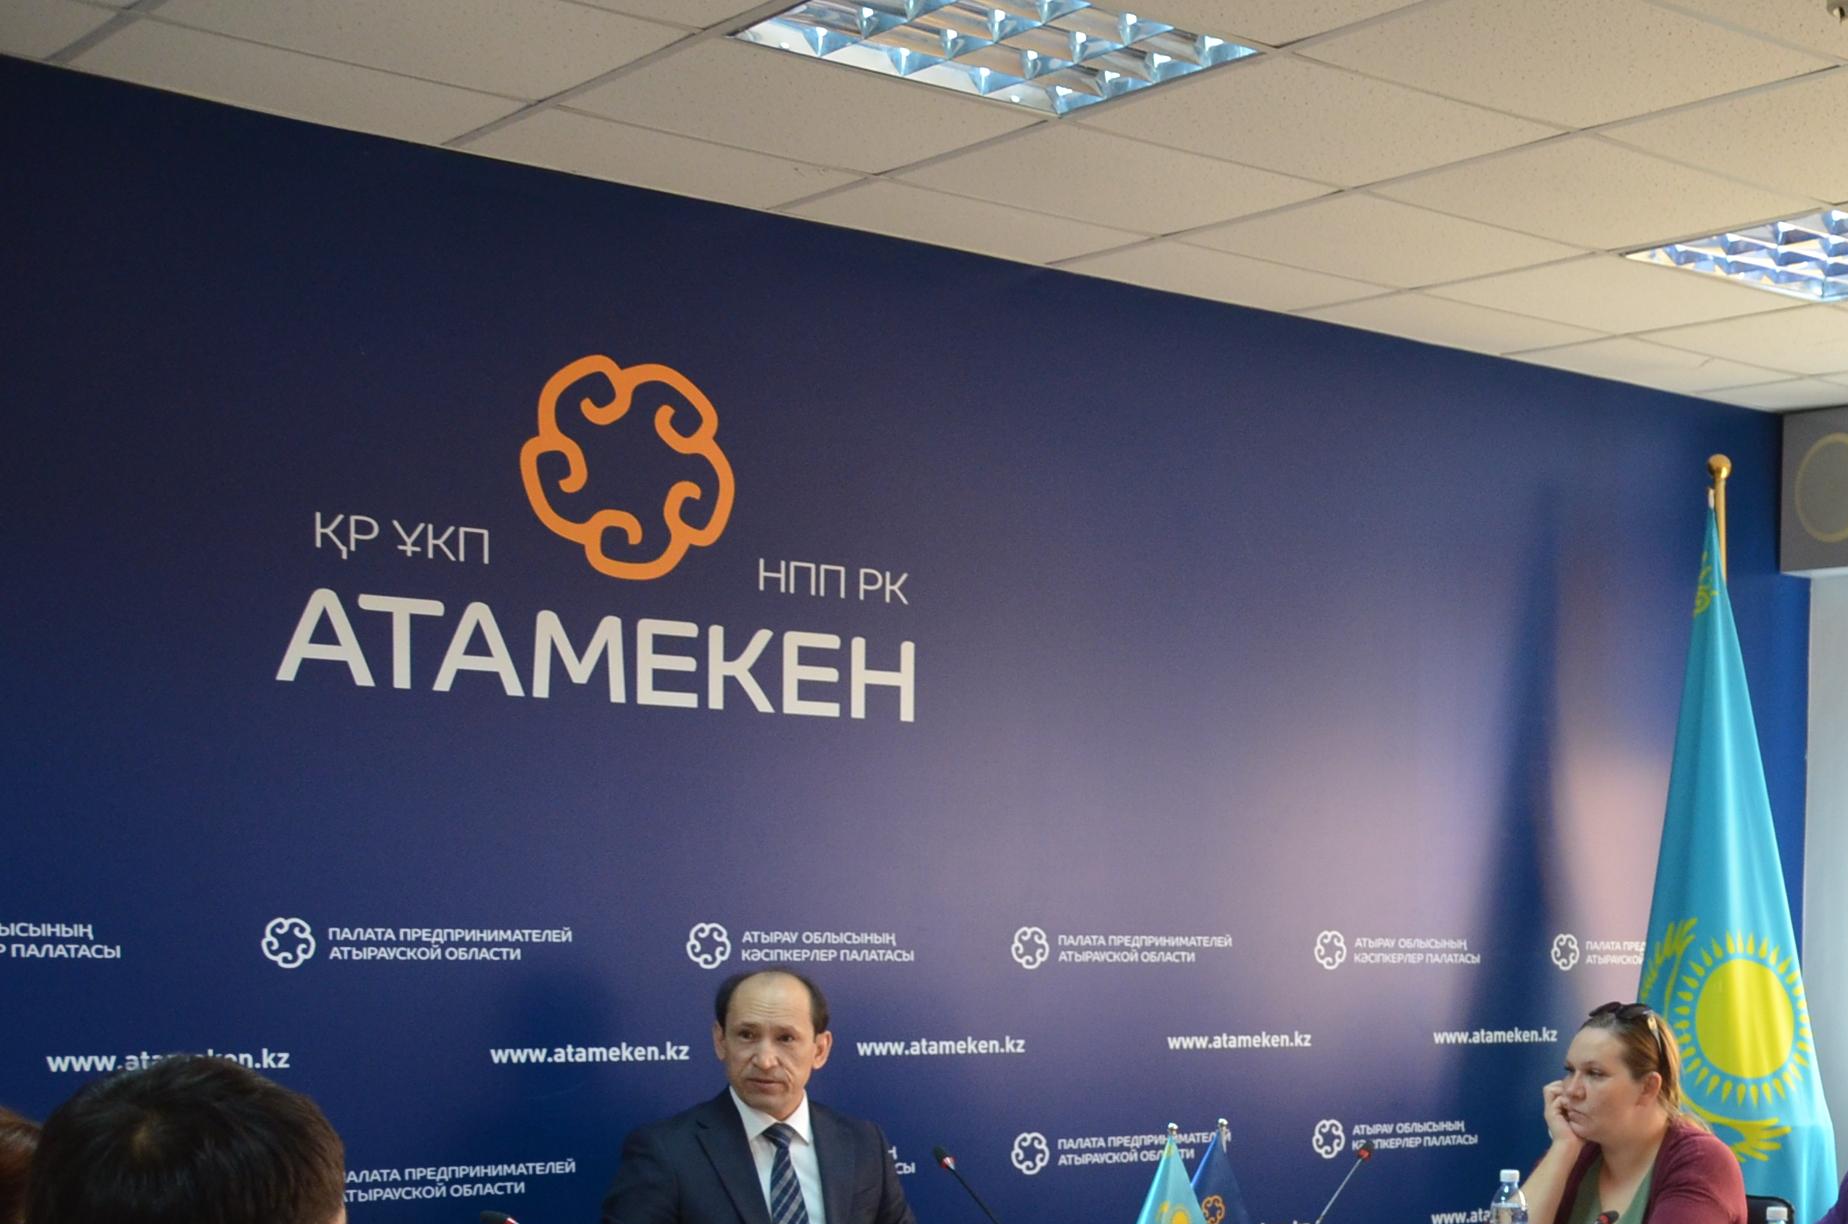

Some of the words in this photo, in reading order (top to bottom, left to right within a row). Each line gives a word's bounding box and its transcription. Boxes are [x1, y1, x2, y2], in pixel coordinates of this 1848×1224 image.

[315, 511, 380, 560] ҚР
[392, 519, 489, 565] ҰКП
[758, 558, 846, 599] НПП
[859, 568, 909, 605] РК
[275, 588, 916, 723] АТАМЕКЕН
[328, 927, 397, 941] ПАЛАТА
[398, 926, 573, 946] ПРЕДПРИНИМАТЕЛЕЙ
[742, 931, 799, 944] АТЫРАУ
[801, 931, 897, 947] ОБЛЫСЫНЫҢ
[1058, 934, 1107, 946] ПАЛАТА
[1108, 932, 1233, 950] ПРЕДПРИНИМАТЕЛЕЙ
[1354, 937, 1396, 949] АТЫРАУ
[1398, 938, 1468, 951] ОБЛЫСЫНЫҢ
[11, 943, 121, 959] ПАЛАТАСЫ
[328, 944, 442, 961] АТЫРАУСКОЙ
[444, 947, 521, 961] ОБЛАСТИ
[1585, 941, 1620, 951] ПАЛАТА
[741, 948, 838, 962] КӘСІПКЕРЛЕР
[839, 949, 915, 962] ПАЛАТАСЫ
[1057, 948, 1139, 964] АТЫРАУСКОЙ
[1140, 951, 1196, 963] ОБЛАСТИ
[1425, 953, 1481, 965] ПАЛАТАСЫ
[1167, 1030, 1312, 1050] www.atameken.kz
[1432, 1027, 1558, 1045] www.atameken.kz
[490, 1041, 690, 1064] www.atameken.kz
[856, 1035, 1026, 1056] www.atameken.kz
[1352, 1122, 1394, 1135] АТЫРАУ
[1395, 1120, 1466, 1134] ОБЛЫСЫНЫҢ
[1057, 1136, 1107, 1150] ПАЛАТА
[1423, 1134, 1479, 1147] ПАЛАТАСЫ
[1057, 1149, 1139, 1166] АТЫРАУСКОЙ
[344, 1168, 402, 1183] АЛАТА
[403, 1158, 577, 1182] ПРЕДПРИНИМАТЕЛЕЙ
[449, 1181, 525, 1198] ОБЛАСТИ
